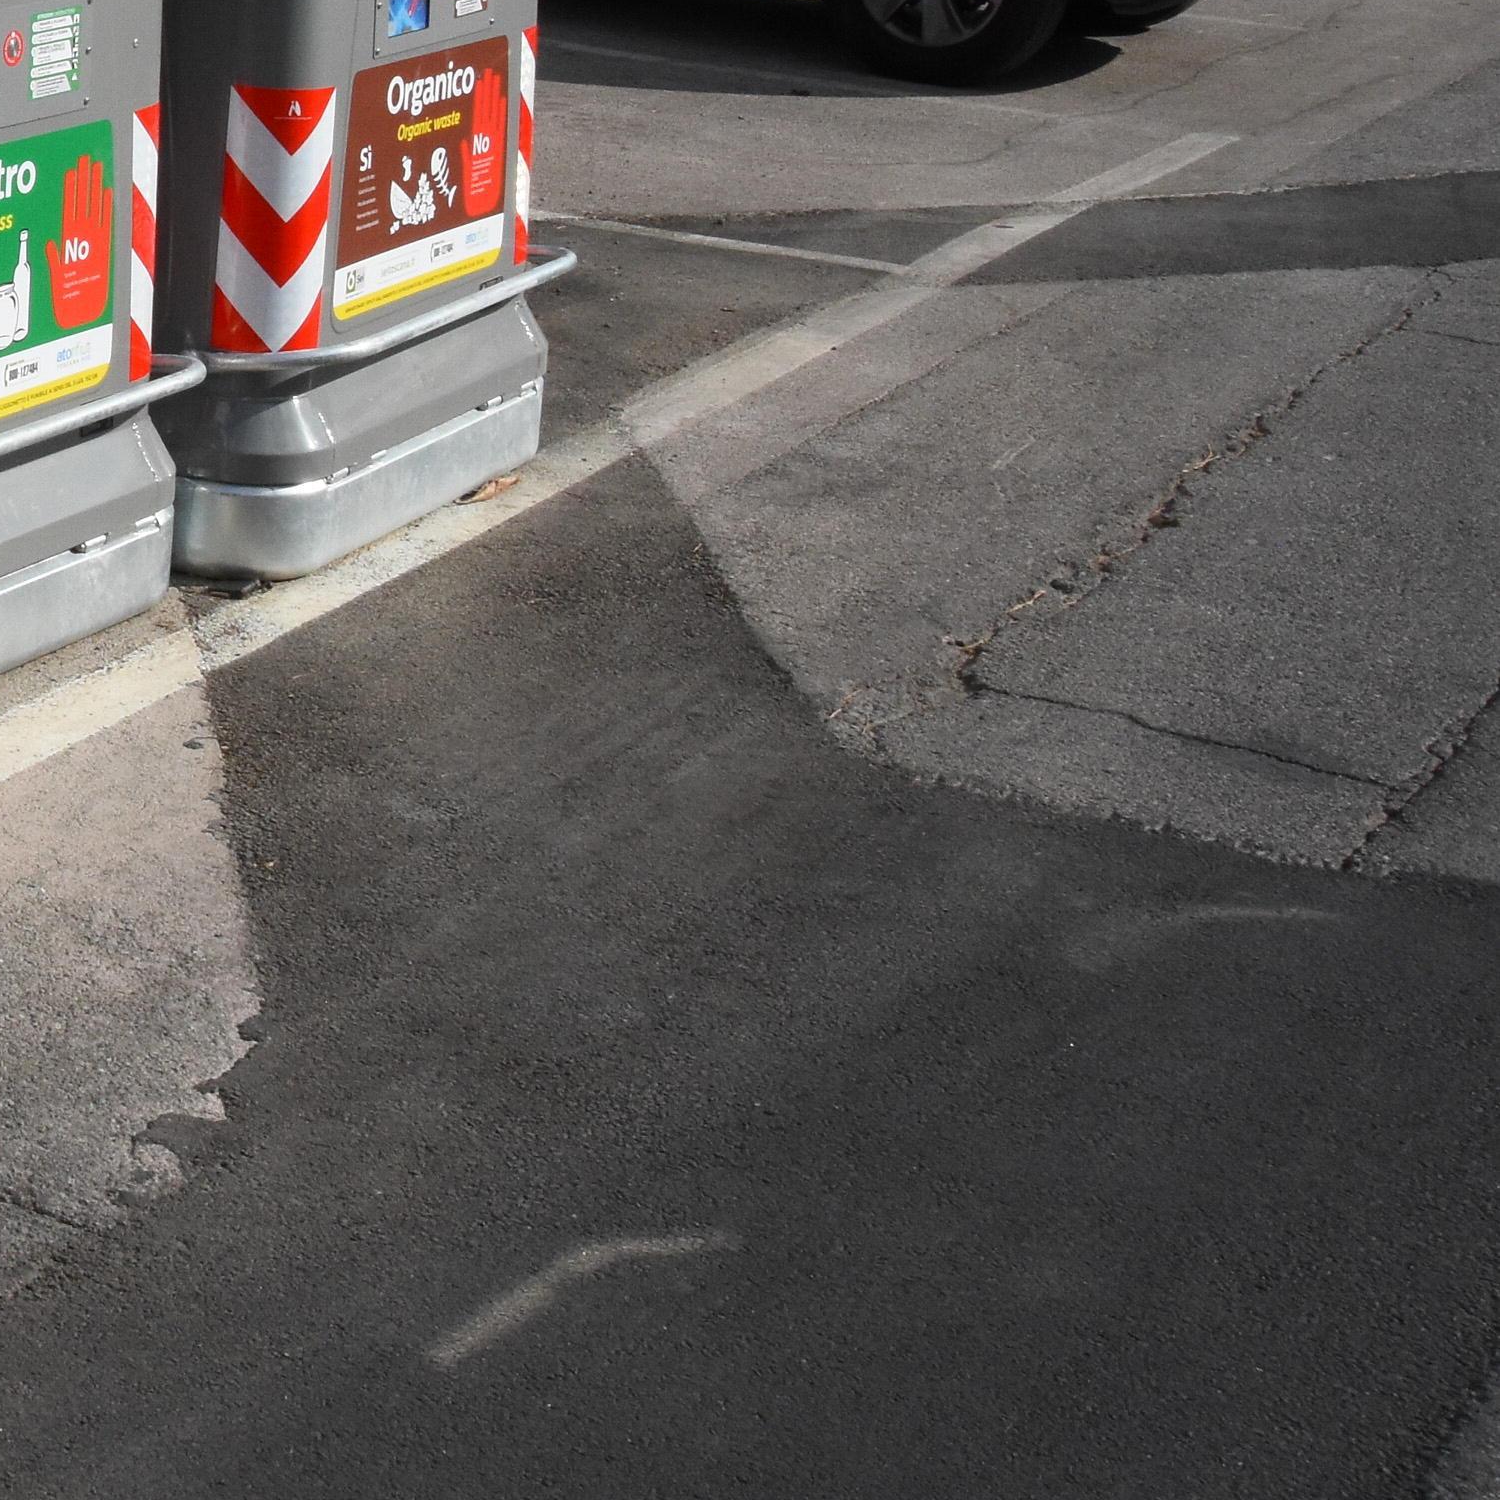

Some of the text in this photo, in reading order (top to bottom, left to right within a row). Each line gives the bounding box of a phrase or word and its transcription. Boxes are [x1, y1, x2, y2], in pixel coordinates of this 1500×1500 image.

[385, 61, 475, 117] Organico
[397, 109, 459, 142] Organic waste
[358, 144, 372, 172] Sì
[472, 133, 489, 155] No
[65, 238, 89, 263] No
